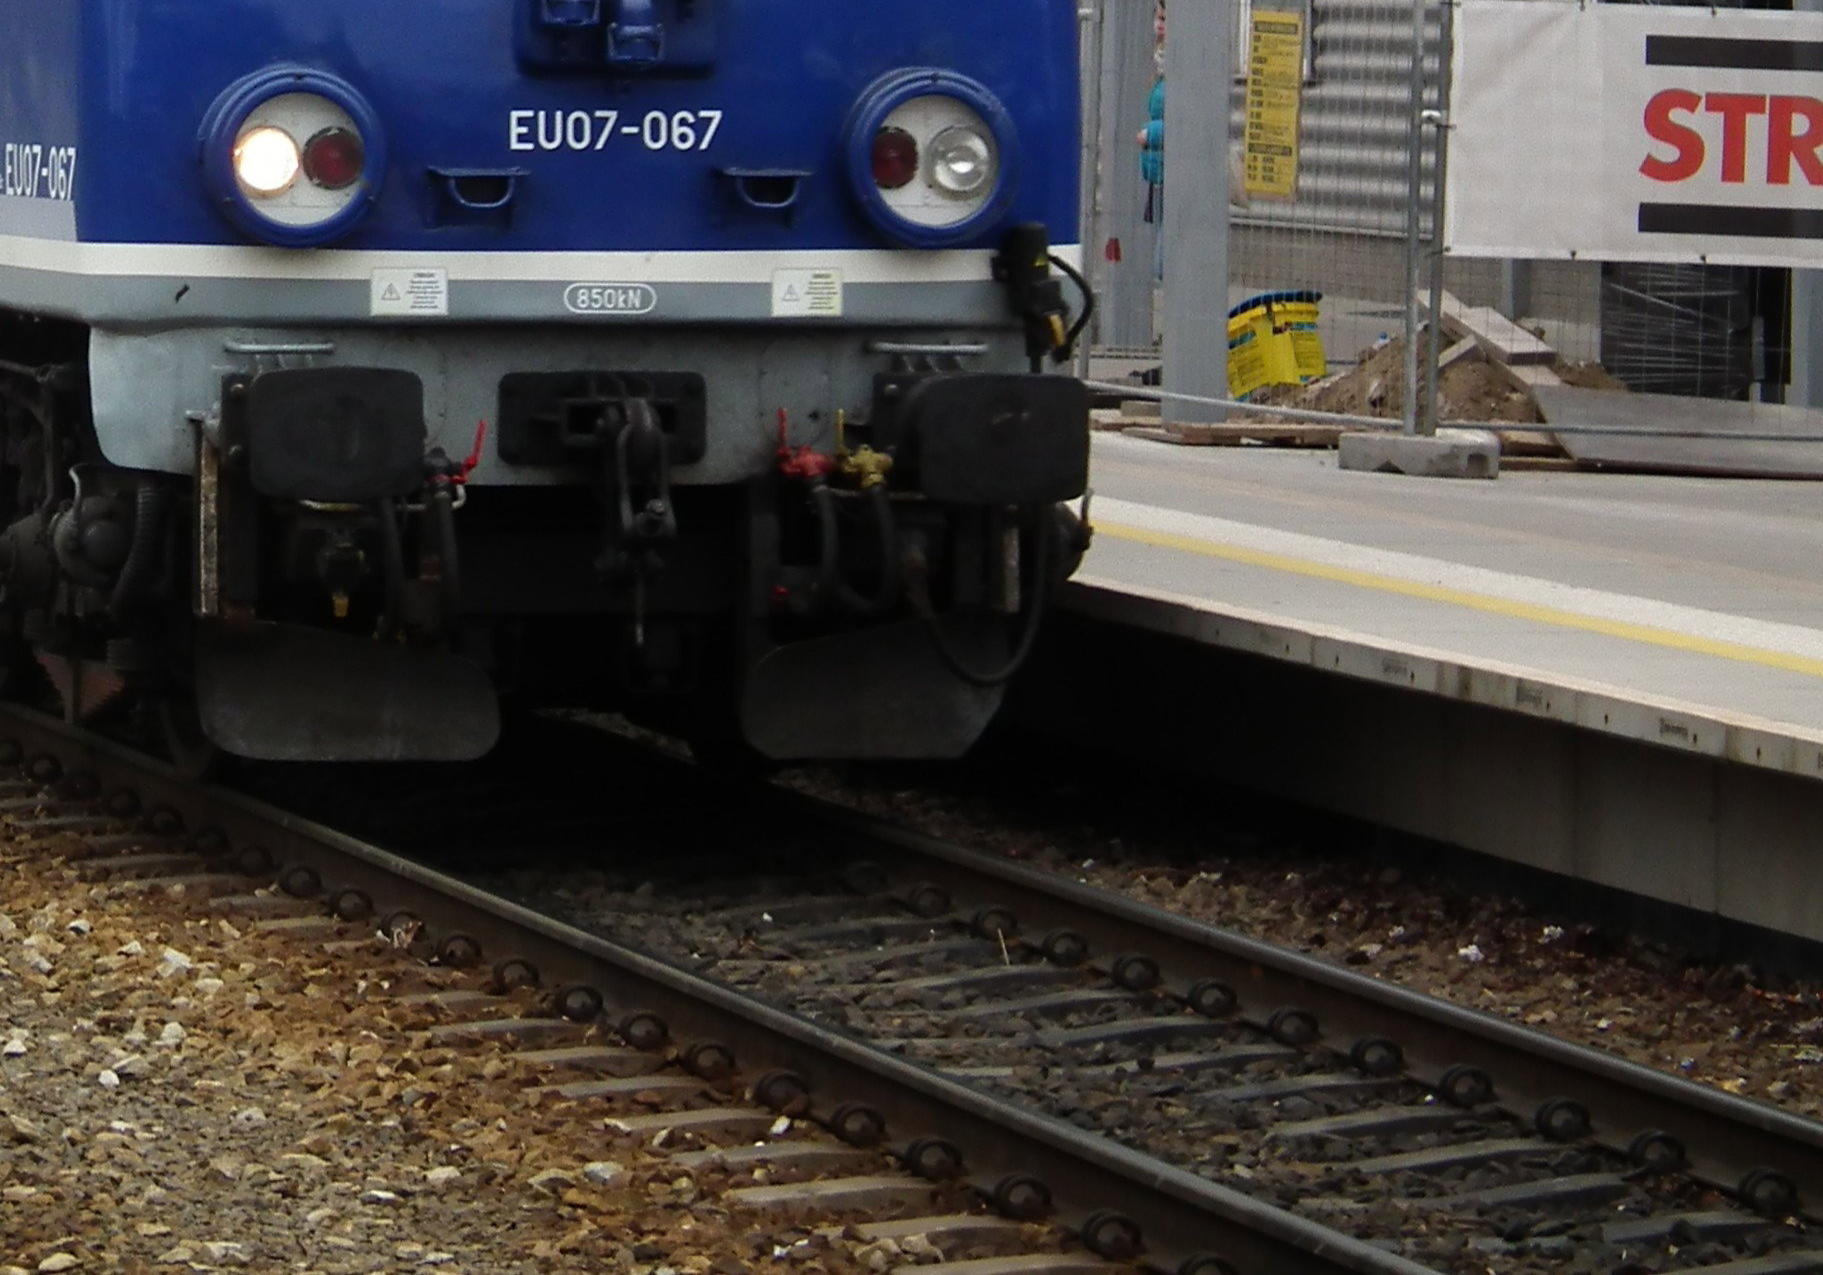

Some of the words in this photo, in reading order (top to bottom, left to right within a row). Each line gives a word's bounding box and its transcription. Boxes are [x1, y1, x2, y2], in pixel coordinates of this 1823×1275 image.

[510, 110, 722, 150] EU07-067
[1639, 88, 1823, 186] STR
[5, 143, 75, 201] EU07-067
[577, 288, 641, 309] 850kN
